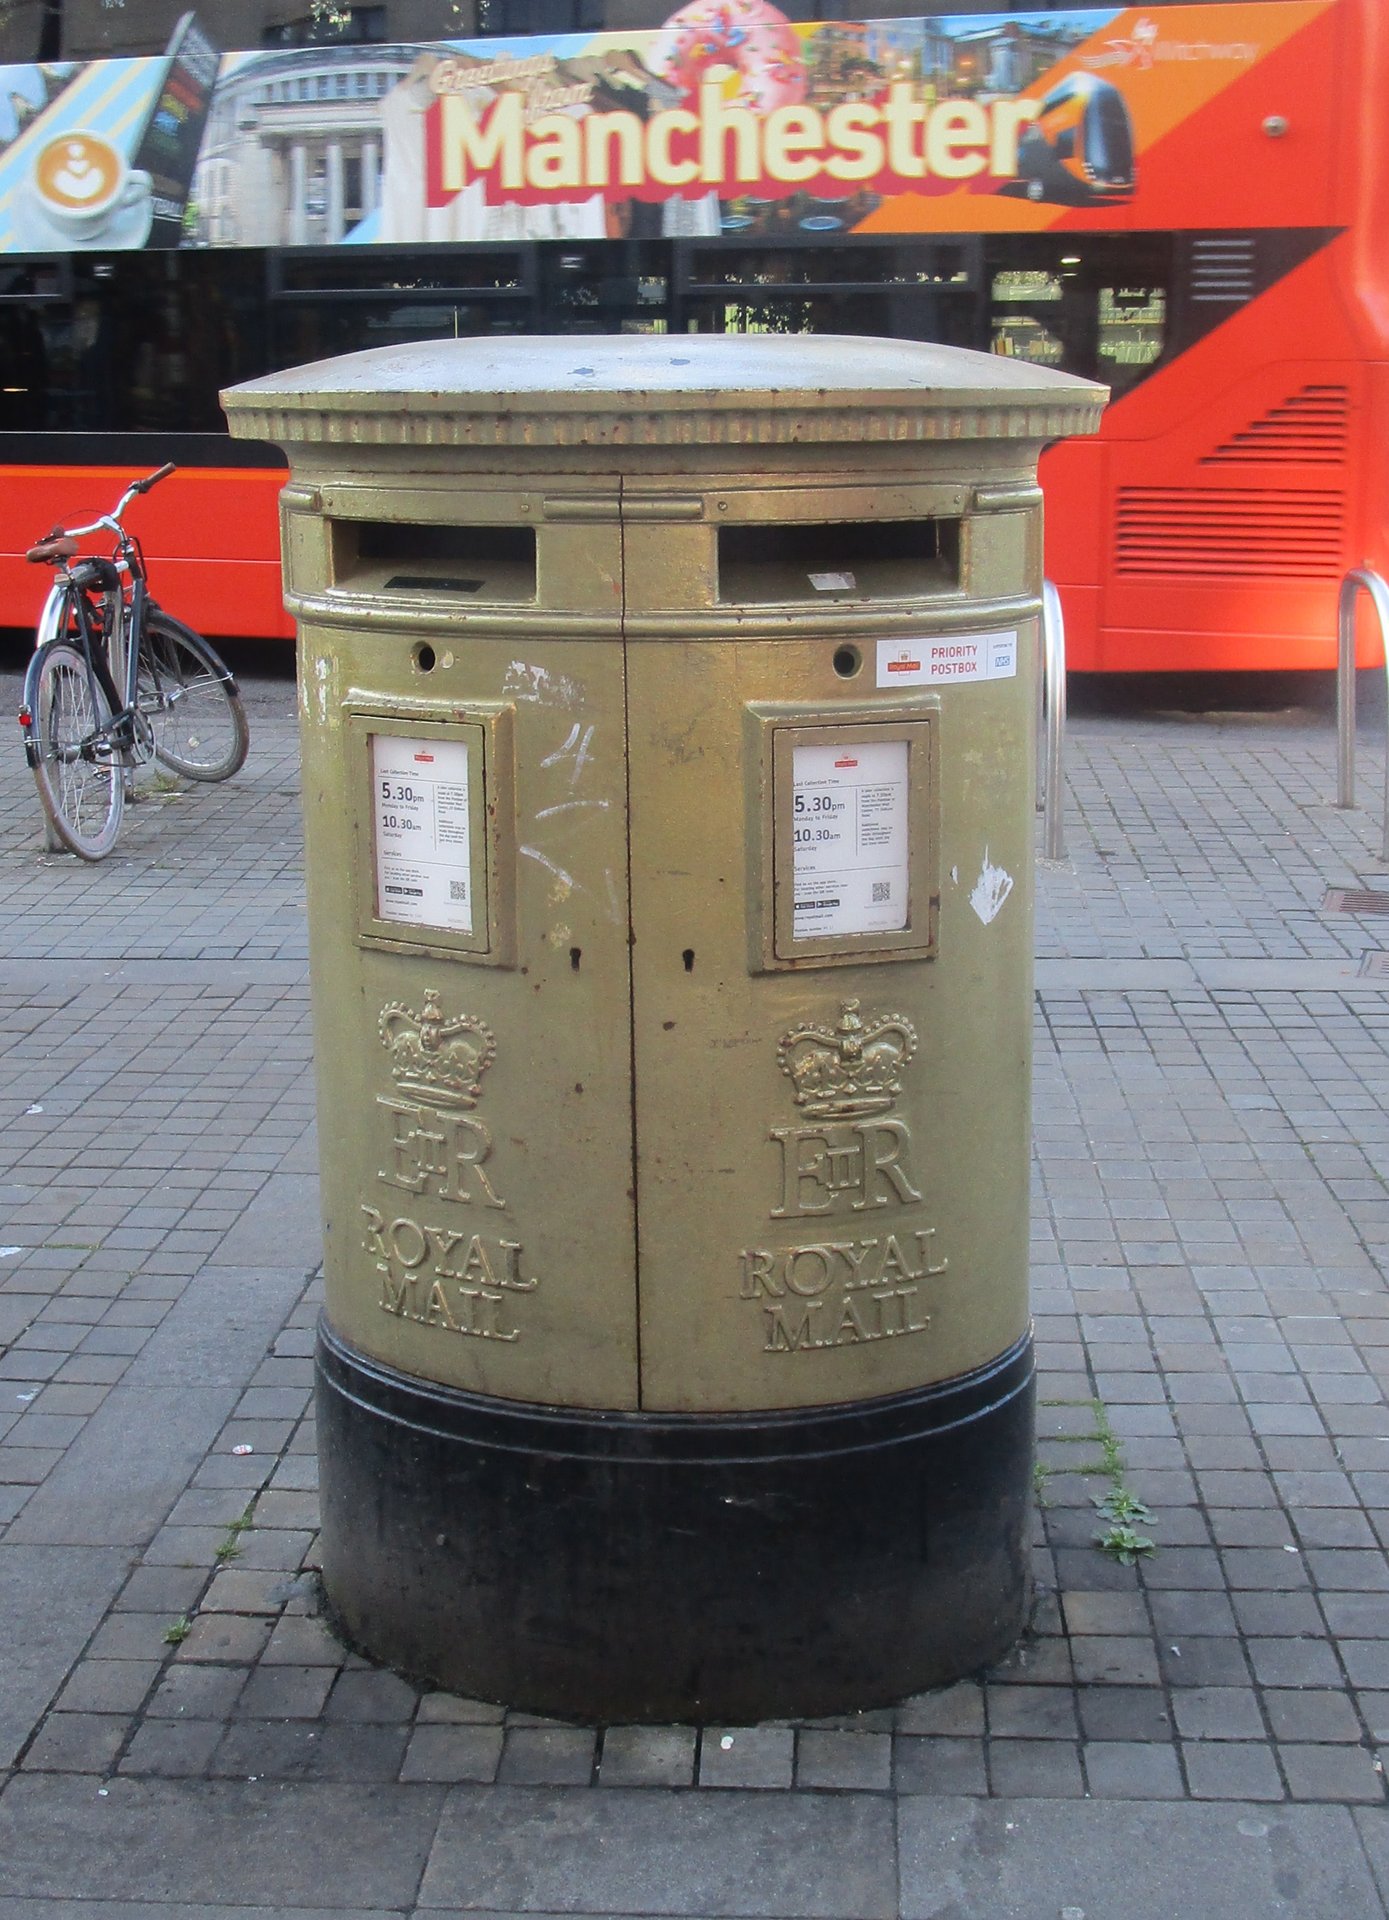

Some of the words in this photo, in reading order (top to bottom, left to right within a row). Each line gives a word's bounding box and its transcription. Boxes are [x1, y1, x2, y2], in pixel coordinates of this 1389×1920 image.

[441, 79, 1045, 191] Manchester
[931, 645, 978, 658] PRIORITY
[995, 656, 1011, 667] NHS
[931, 662, 977, 675] POSTBOX
[382, 782, 425, 803] 5.30pm
[794, 794, 846, 813] 5.30pm
[382, 815, 422, 831] 10.30am
[793, 828, 841, 843] 10.30am
[361, 1204, 538, 1291] ROYAL
[738, 1228, 949, 1300] ROYAL
[376, 1262, 521, 1343] MAIL
[763, 1286, 932, 1353] MAIL
